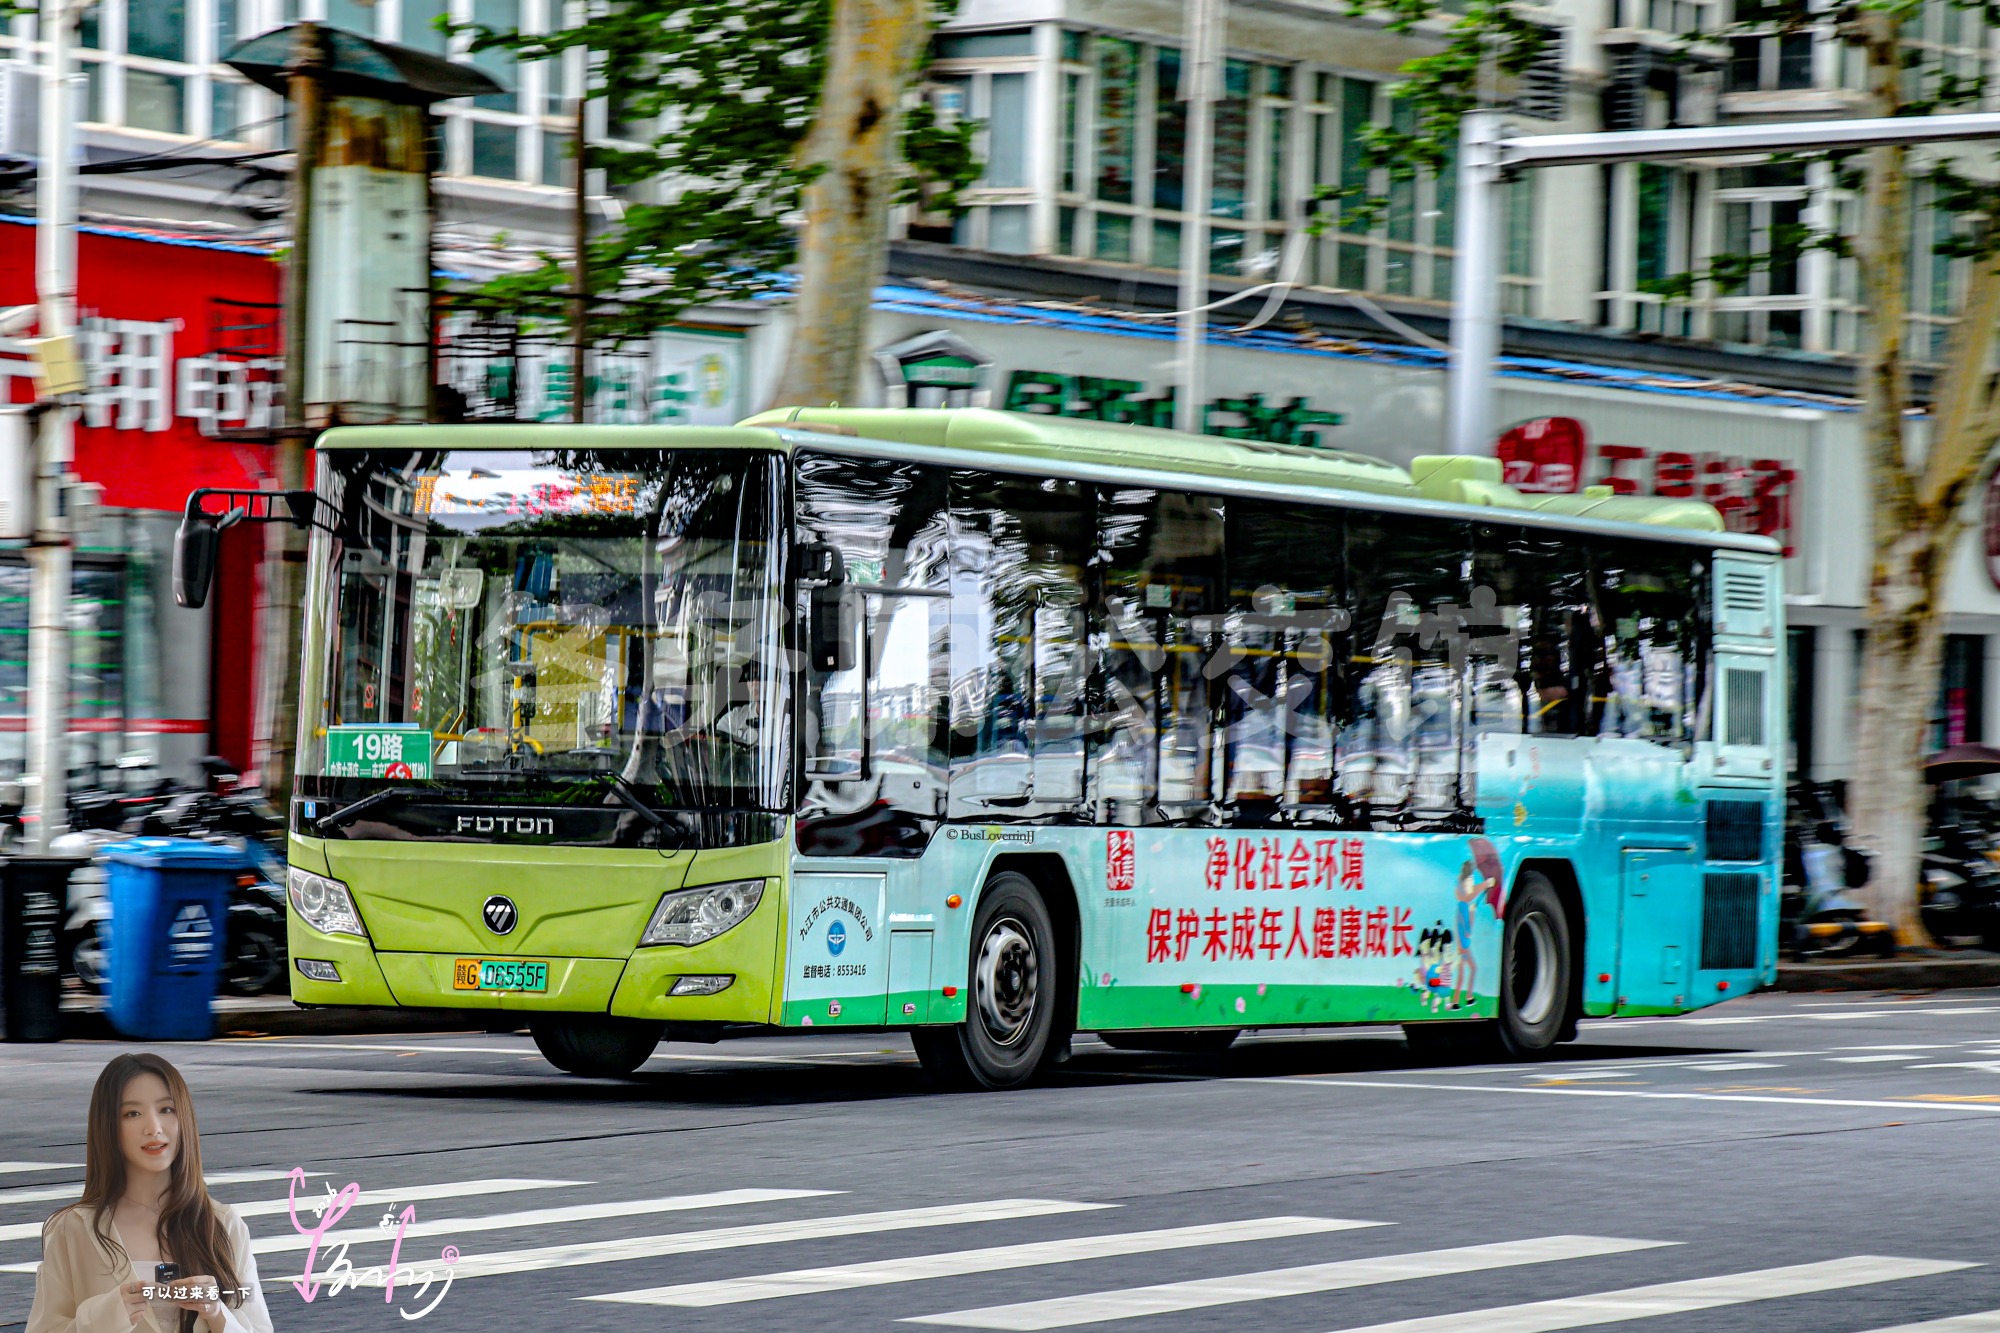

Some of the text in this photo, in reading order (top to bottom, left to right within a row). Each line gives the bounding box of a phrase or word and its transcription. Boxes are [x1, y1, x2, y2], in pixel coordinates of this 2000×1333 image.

[352, 733, 403, 761] 19路
[457, 815, 554, 835] FOTON
[1204, 836, 1366, 891] 净化社会环境
[799, 895, 873, 942] 九江市公共交通集团公司
[1146, 905, 1415, 963] 保护未成年人健康成长
